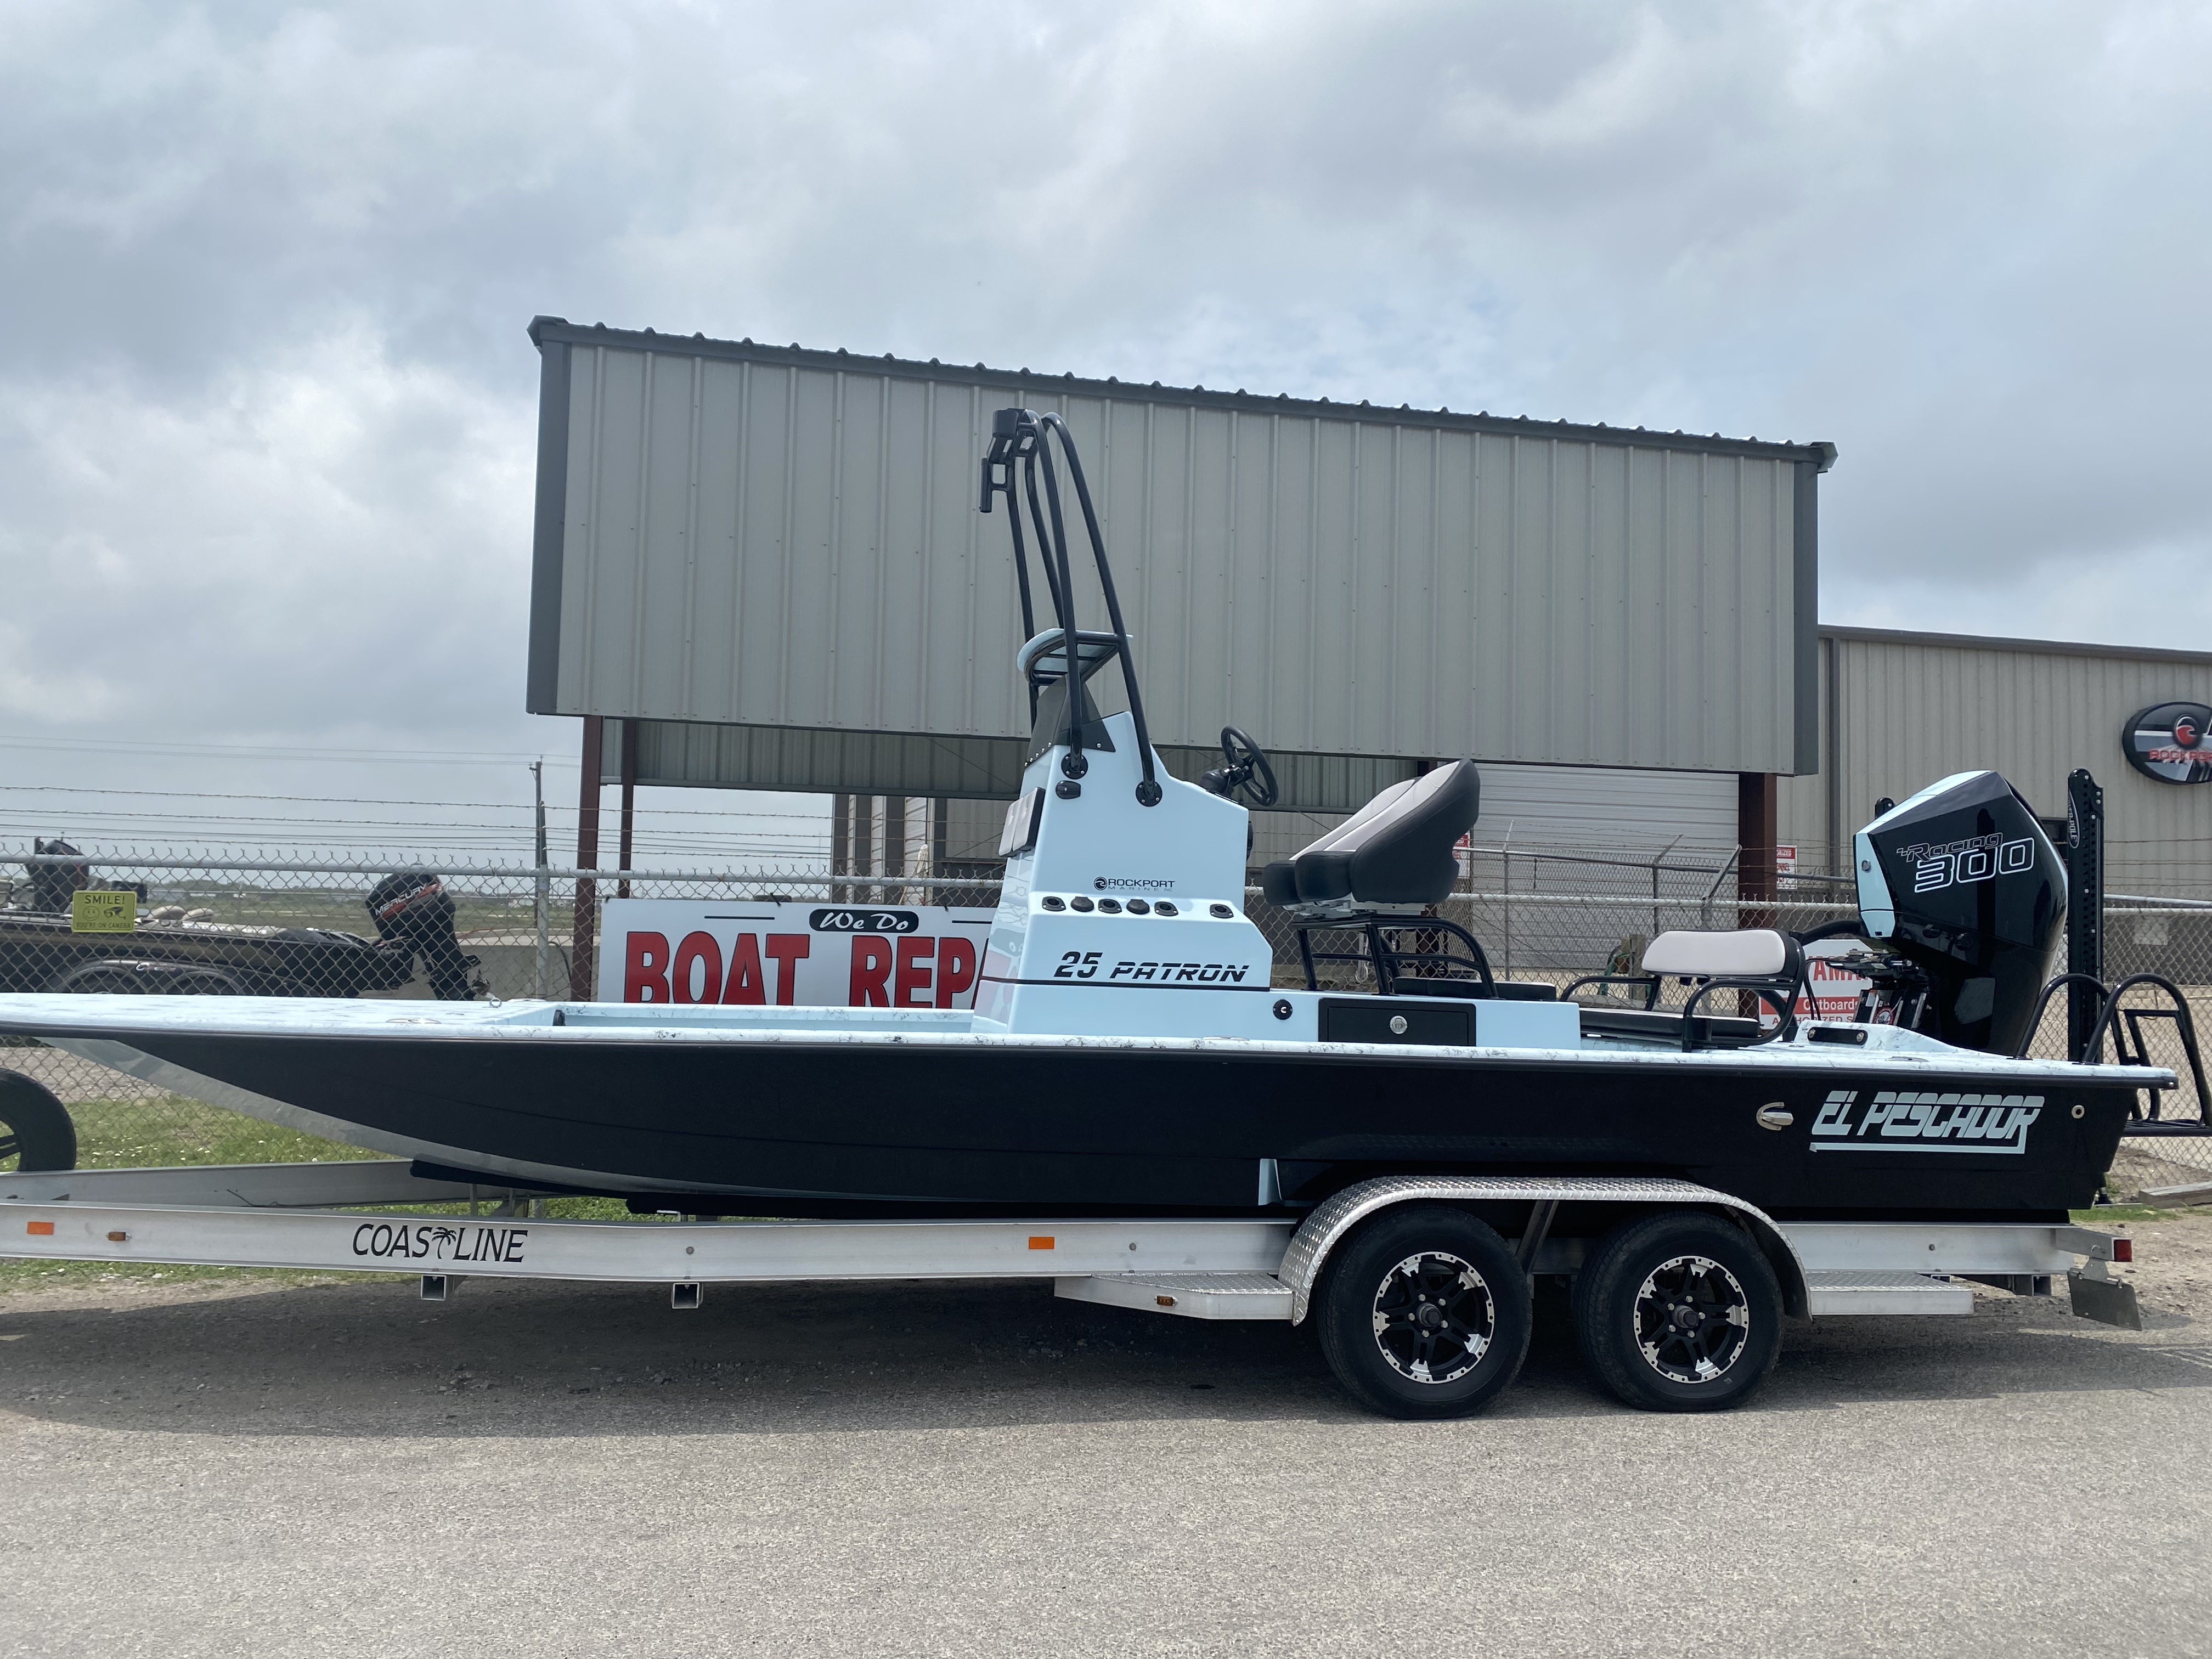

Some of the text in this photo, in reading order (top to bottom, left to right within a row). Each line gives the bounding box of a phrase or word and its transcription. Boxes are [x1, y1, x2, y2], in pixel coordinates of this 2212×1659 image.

[1906, 832, 2004, 862] Racing
[1914, 837, 2035, 893] 300
[1108, 878, 1175, 888] ROCKPORT
[84, 895, 125, 904] SMILE!
[375, 883, 428, 916] MERCURY
[819, 911, 909, 931] We Do
[624, 930, 989, 1009] BOAT REP
[1053, 951, 1250, 983] 25 PATRON
[1812, 1090, 2045, 1140] EL PESCADOR
